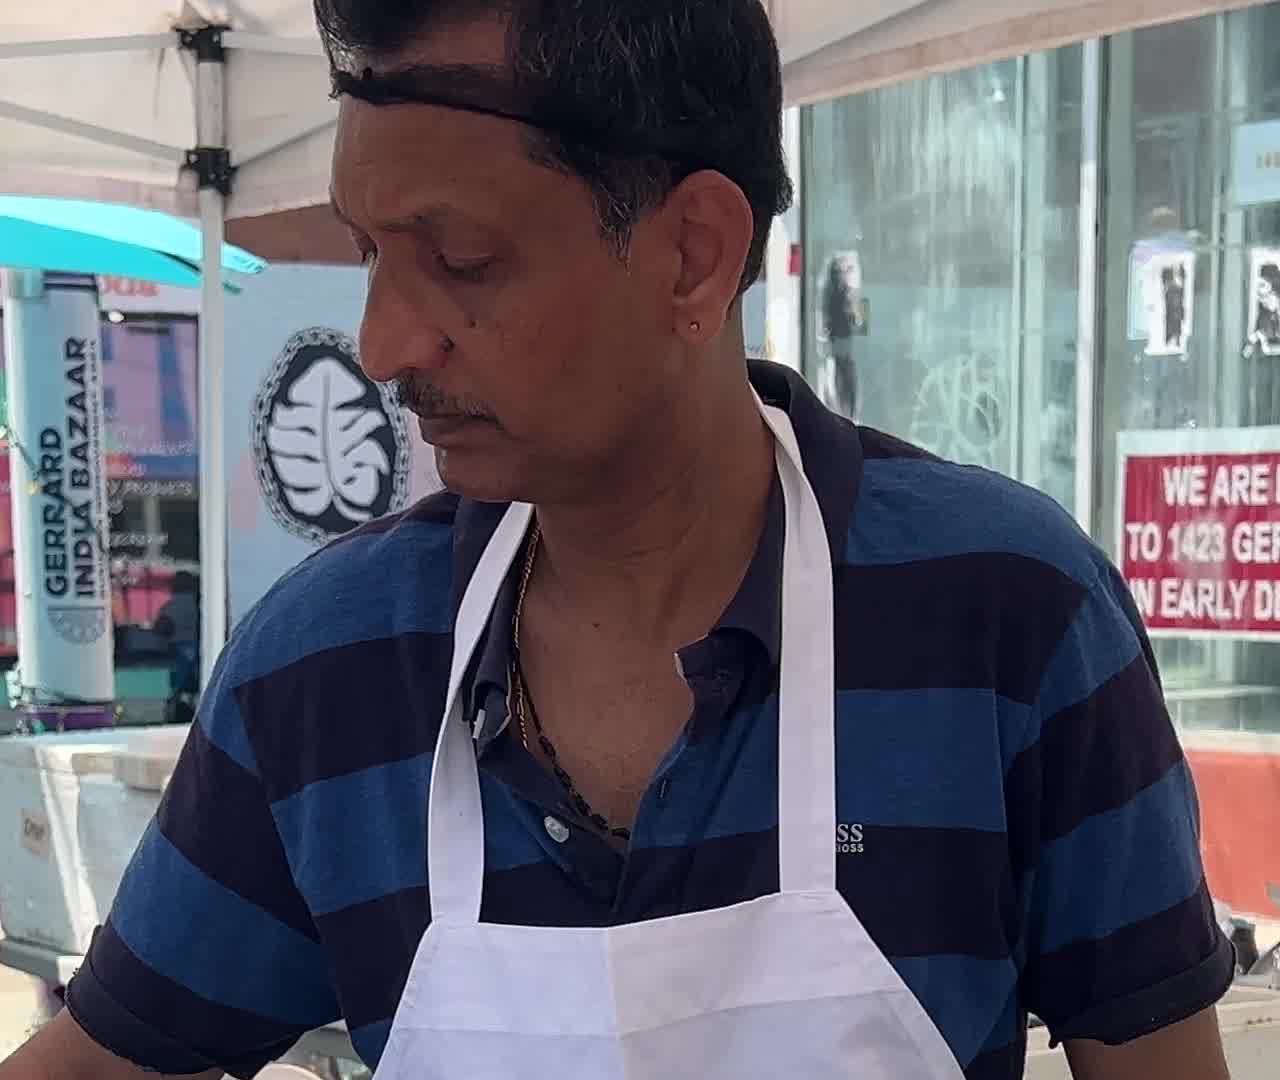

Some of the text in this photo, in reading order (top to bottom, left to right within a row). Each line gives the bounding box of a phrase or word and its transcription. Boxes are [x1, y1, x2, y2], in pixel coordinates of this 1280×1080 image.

[65, 337, 96, 597] INDIA BAZAAR
[1162, 465, 1205, 507] WE
[1213, 464, 1271, 505] ARE
[40, 426, 68, 597] GERRARD
[1125, 524, 1162, 563] TO
[1168, 522, 1226, 562] 1423
[1164, 577, 1250, 620] EARLY
[836, 823, 864, 843] SS
